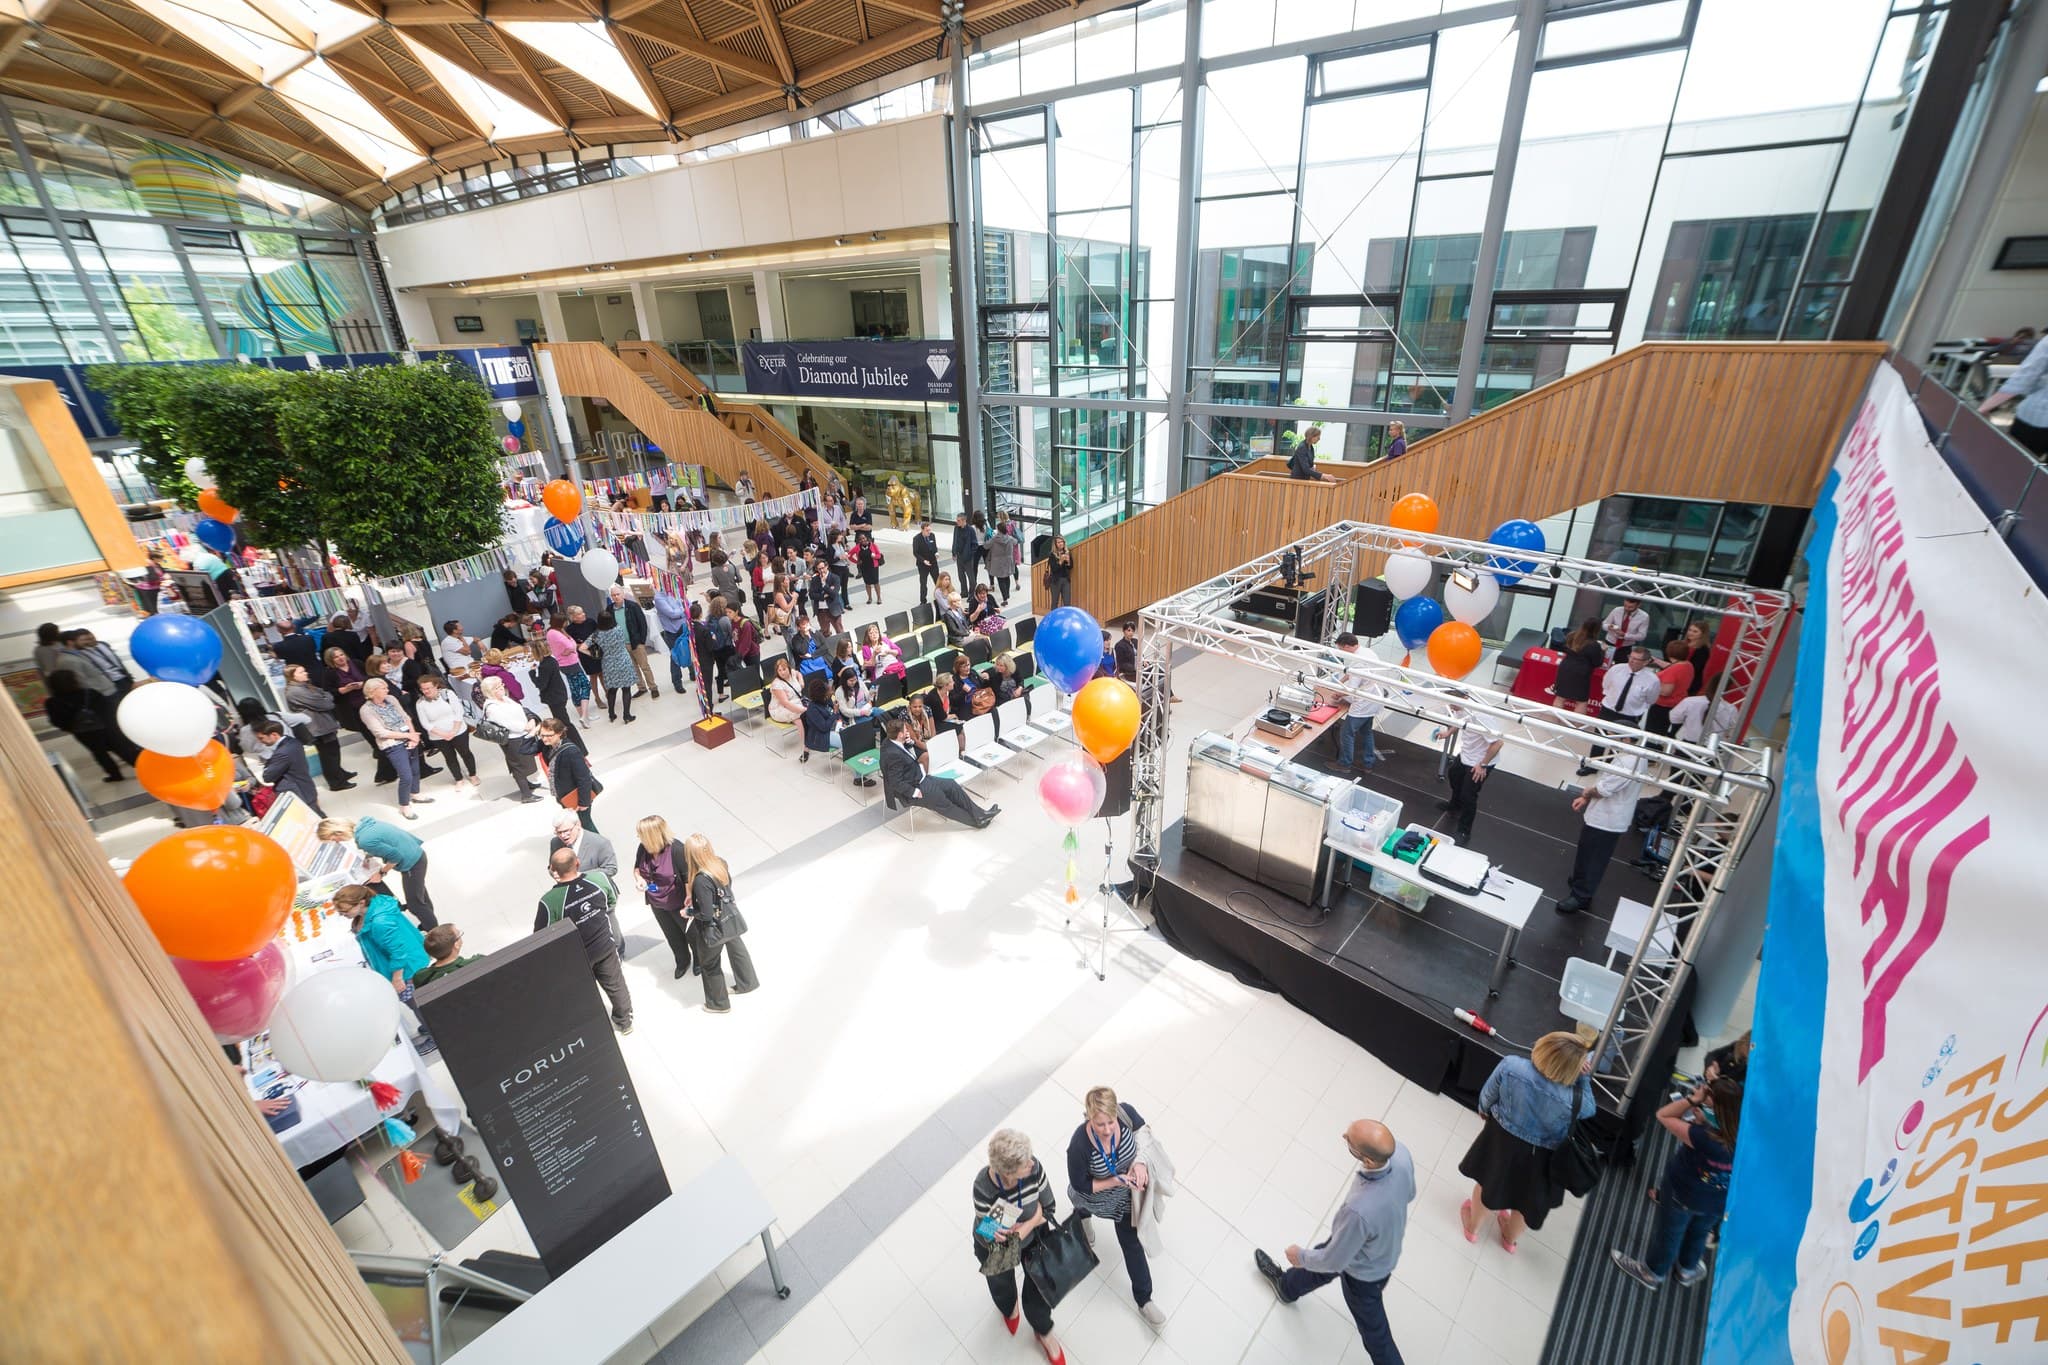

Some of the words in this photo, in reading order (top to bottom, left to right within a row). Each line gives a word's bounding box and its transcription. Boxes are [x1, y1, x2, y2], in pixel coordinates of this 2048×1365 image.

[513, 363, 532, 378] 100
[797, 353, 834, 366] Celebrating
[835, 356, 848, 364] our
[482, 357, 516, 385] THE
[799, 366, 858, 385] Diamond
[862, 367, 909, 388] Jubilee
[499, 1037, 586, 1094] FORUM
